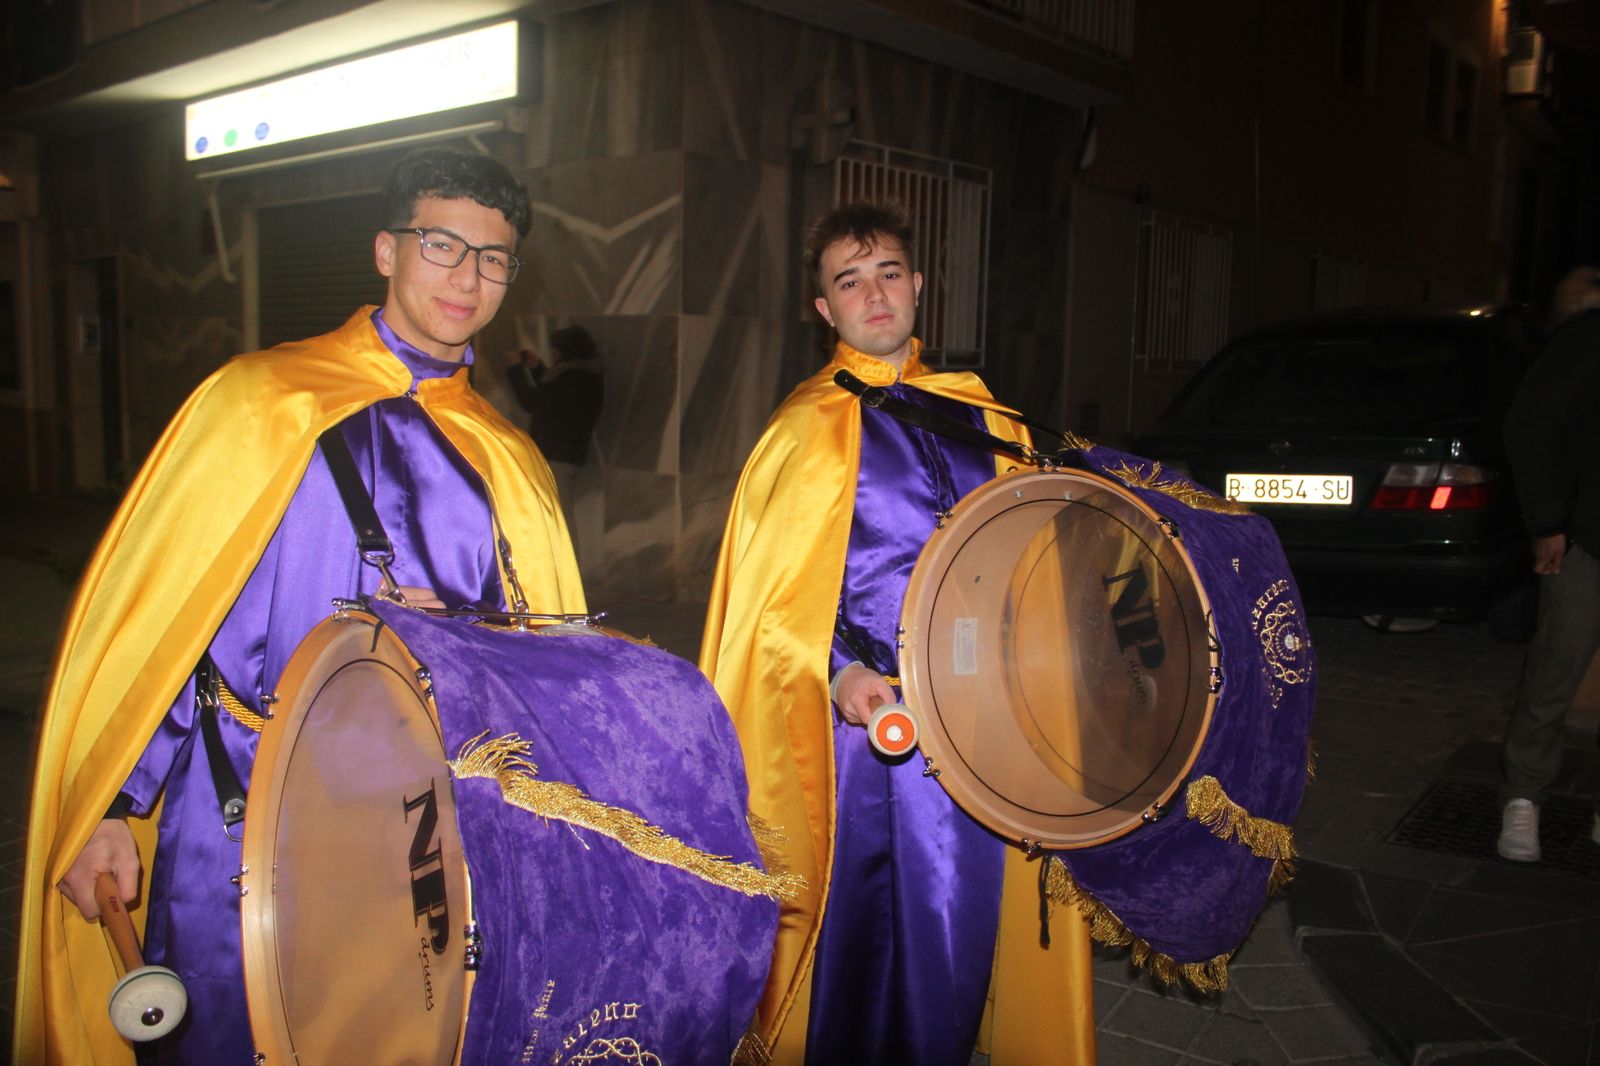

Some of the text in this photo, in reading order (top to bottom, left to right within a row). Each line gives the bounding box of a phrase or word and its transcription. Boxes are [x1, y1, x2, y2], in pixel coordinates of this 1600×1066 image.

[1229, 478, 1350, 500] B 8854 SU
[1102, 561, 1166, 670] NP
[403, 777, 450, 956] NP
[418, 936, 436, 1013] drums
